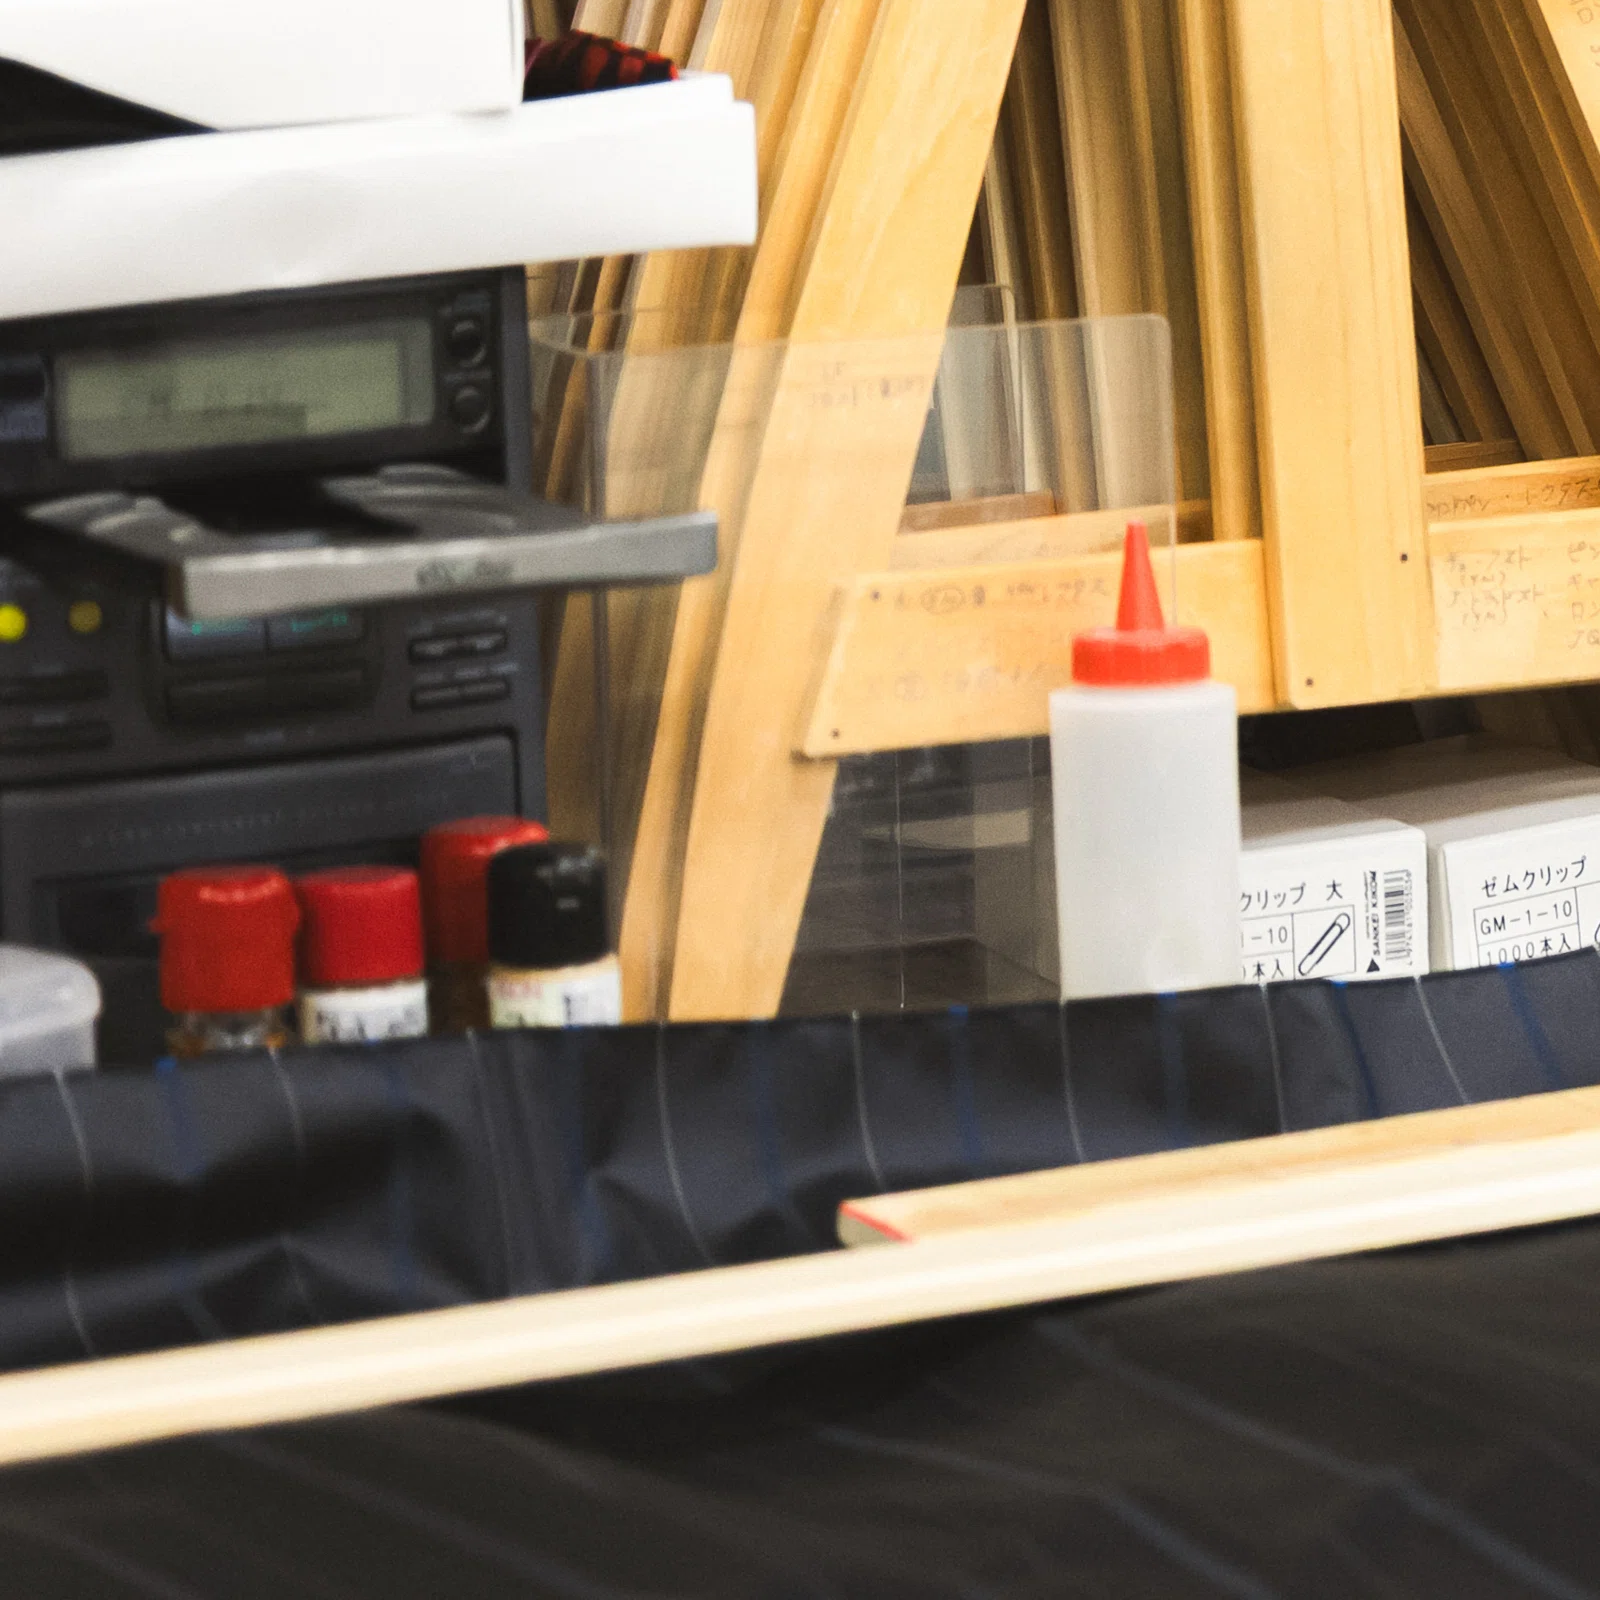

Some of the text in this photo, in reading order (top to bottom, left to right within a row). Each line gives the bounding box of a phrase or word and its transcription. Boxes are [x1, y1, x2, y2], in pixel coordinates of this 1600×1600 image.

[1326, 879, 1343, 901] 大
[1481, 855, 1587, 898] ゼムクリップ
[1480, 900, 1572, 936] GM-1-10
